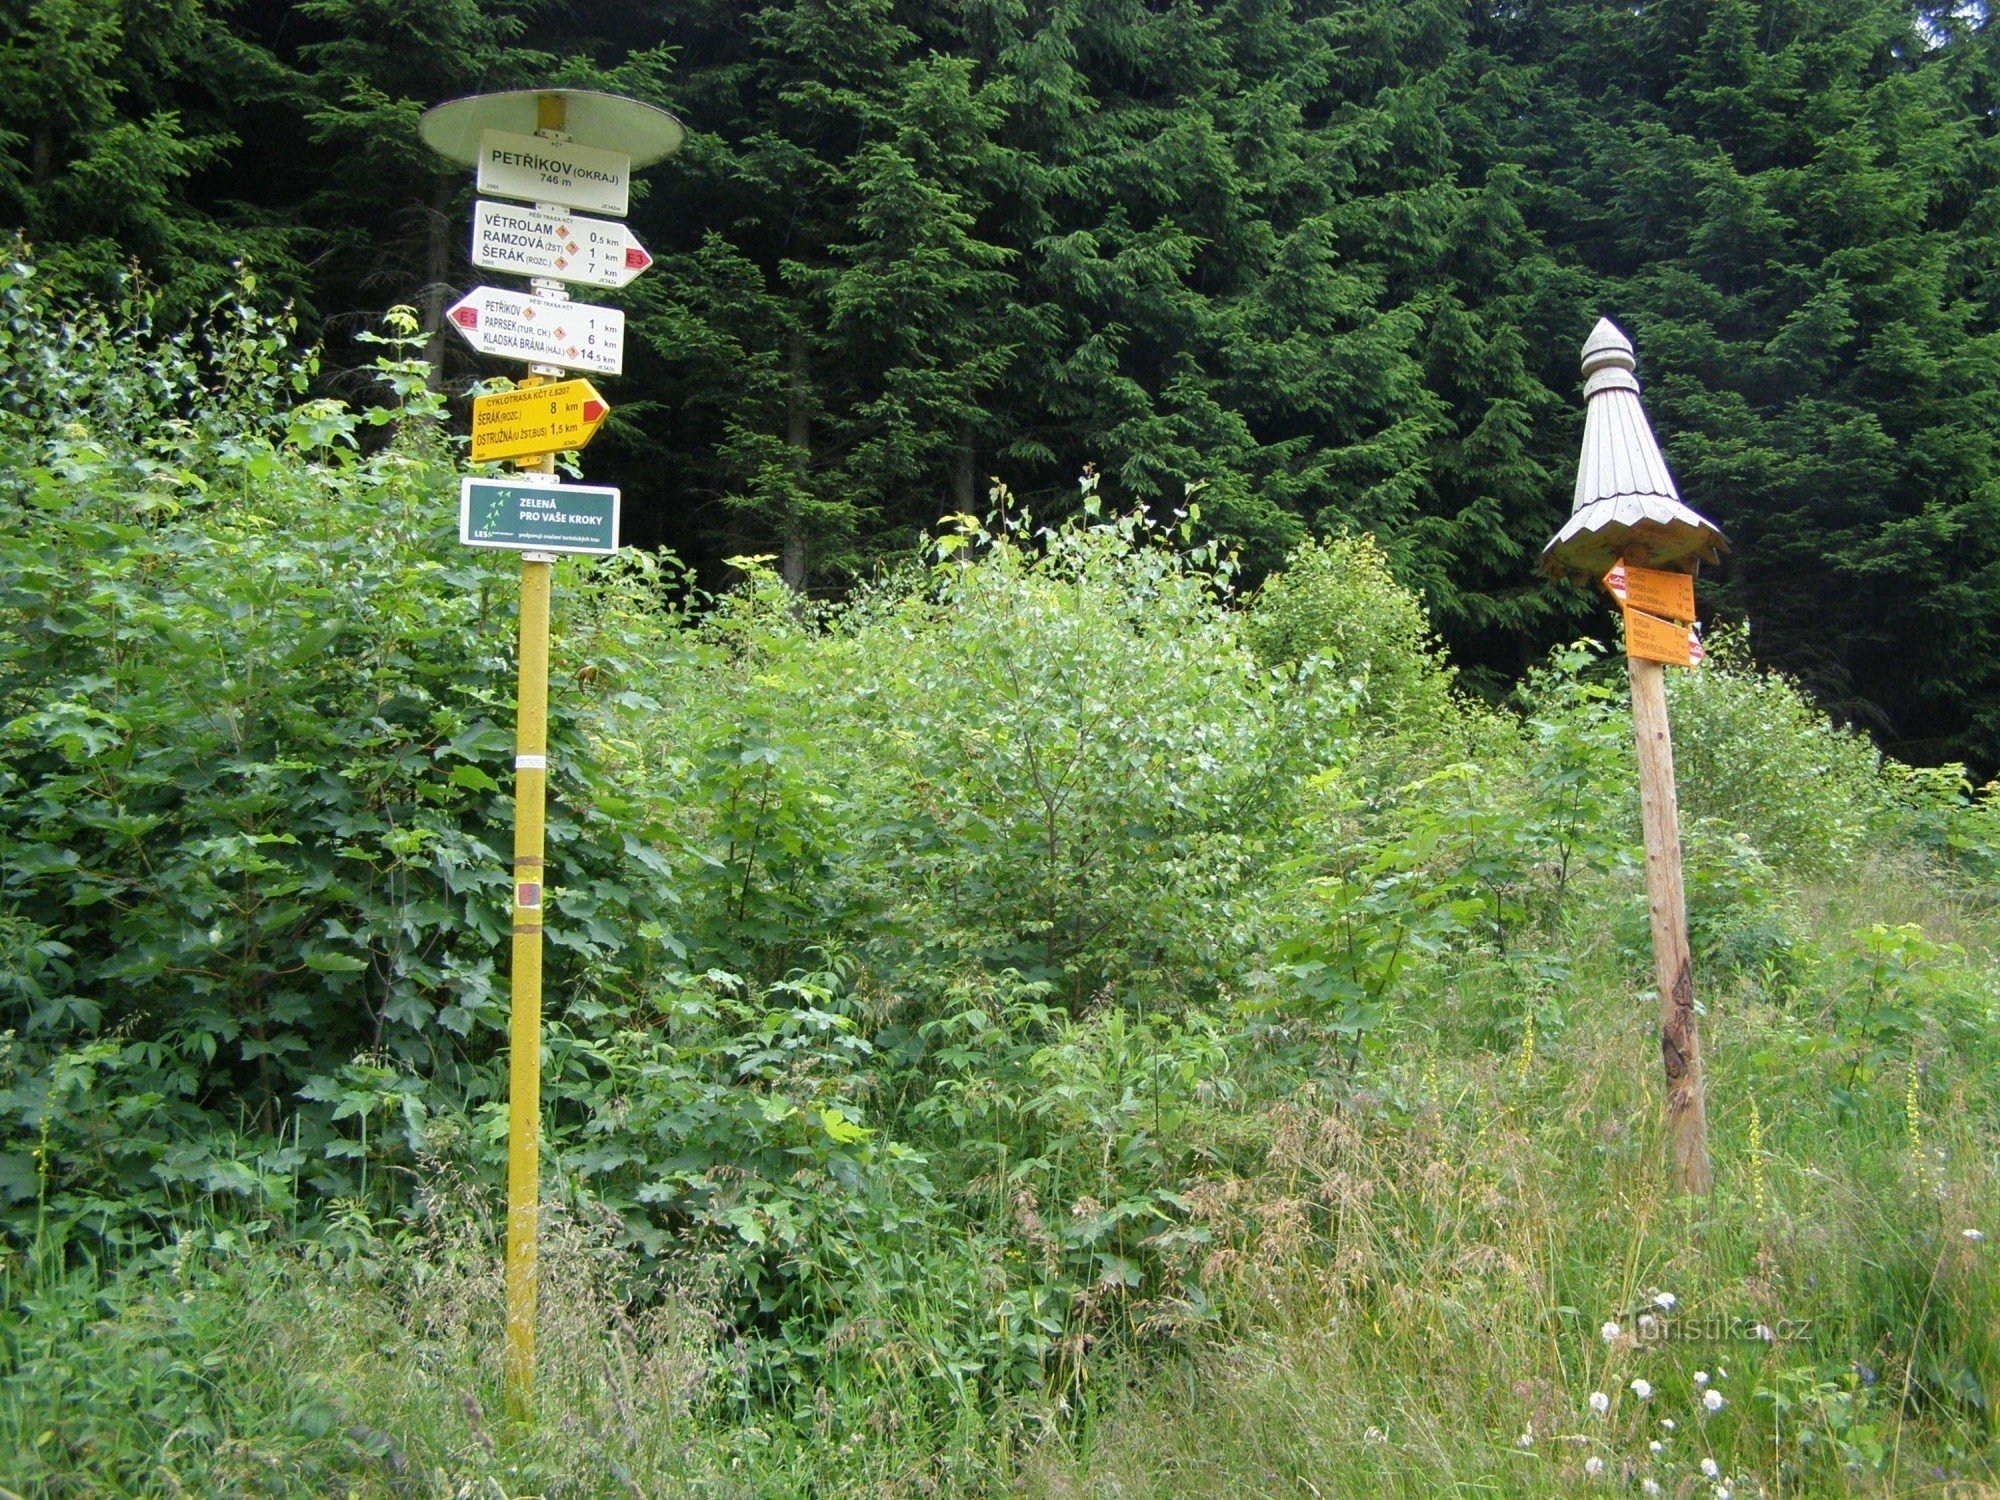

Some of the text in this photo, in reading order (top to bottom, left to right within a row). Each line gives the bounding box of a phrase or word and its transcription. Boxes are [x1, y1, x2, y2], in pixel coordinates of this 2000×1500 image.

[492, 150, 619, 185] PETŘÍKOV (OKRAJ)
[540, 173, 559, 185] 746
[483, 230, 618, 262] RAMZOVÁ (ŽST) 1 km
[485, 214, 620, 247] VĚTROLAM 0,5 km
[482, 246, 617, 277] ŠERÁK (ROZC.) 7 km
[485, 300, 617, 333] PETŘÍKOV 1 km
[483, 332, 518, 348] KLADSKÁ
[519, 337, 544, 351] BRÁNA
[580, 349, 601, 362] 14,5
[602, 355, 616, 364] km
[484, 316, 517, 332] PAPRSEK
[588, 335, 595, 345] 6
[604, 340, 617, 349] km
[486, 392, 532, 407] CYKLOTRASA
[533, 388, 547, 399] KČT
[477, 410, 501, 426] ŠERÁK
[550, 402, 557, 414] 8
[565, 403, 579, 412] km
[476, 427, 512, 447] OSTRUŽNÁ
[550, 423, 563, 436] 1,5
[565, 424, 578, 433] km
[519, 498, 557, 509] ZELENÁ
[519, 511, 603, 526] PRO VAŠE KROKY
